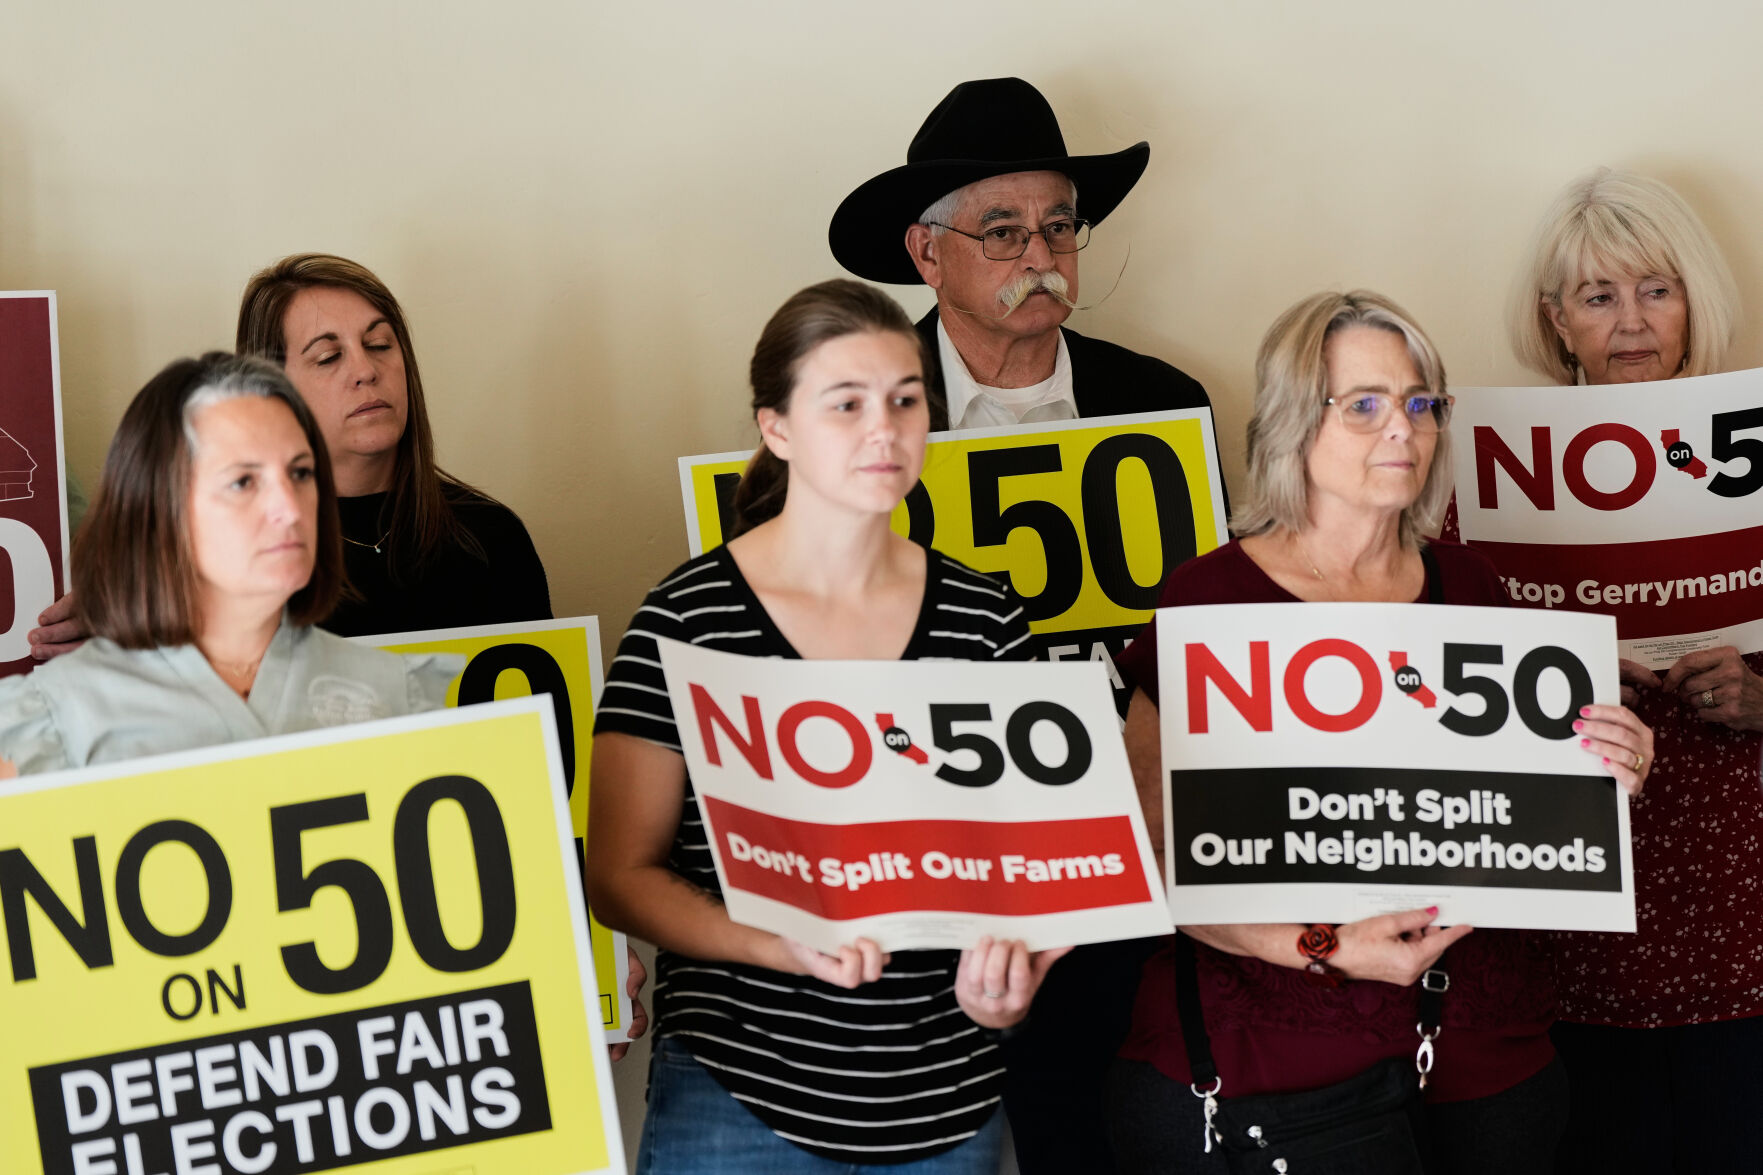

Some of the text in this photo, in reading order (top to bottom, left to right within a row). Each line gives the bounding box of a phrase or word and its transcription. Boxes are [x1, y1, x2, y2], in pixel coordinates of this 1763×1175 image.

[1473, 422, 1657, 511] NO
[1670, 448, 1690, 461] on
[967, 433, 1198, 622] 50
[1499, 575, 1566, 608] top
[687, 682, 1093, 789] NO on 50
[1184, 638, 1383, 734] NO
[1396, 671, 1420, 686] on
[1438, 642, 1594, 741] 50
[1190, 830, 1607, 873] Our Neighborhoods
[1416, 789, 1512, 829] Split
[0, 774, 518, 994] NO 50
[820, 851, 914, 891] Split
[921, 850, 993, 882] Our
[1001, 852, 1125, 883] Farms
[161, 964, 247, 1021] ON
[60, 998, 511, 1135] DEFEND FAIR
[71, 1066, 522, 1175] ELECTIONS
